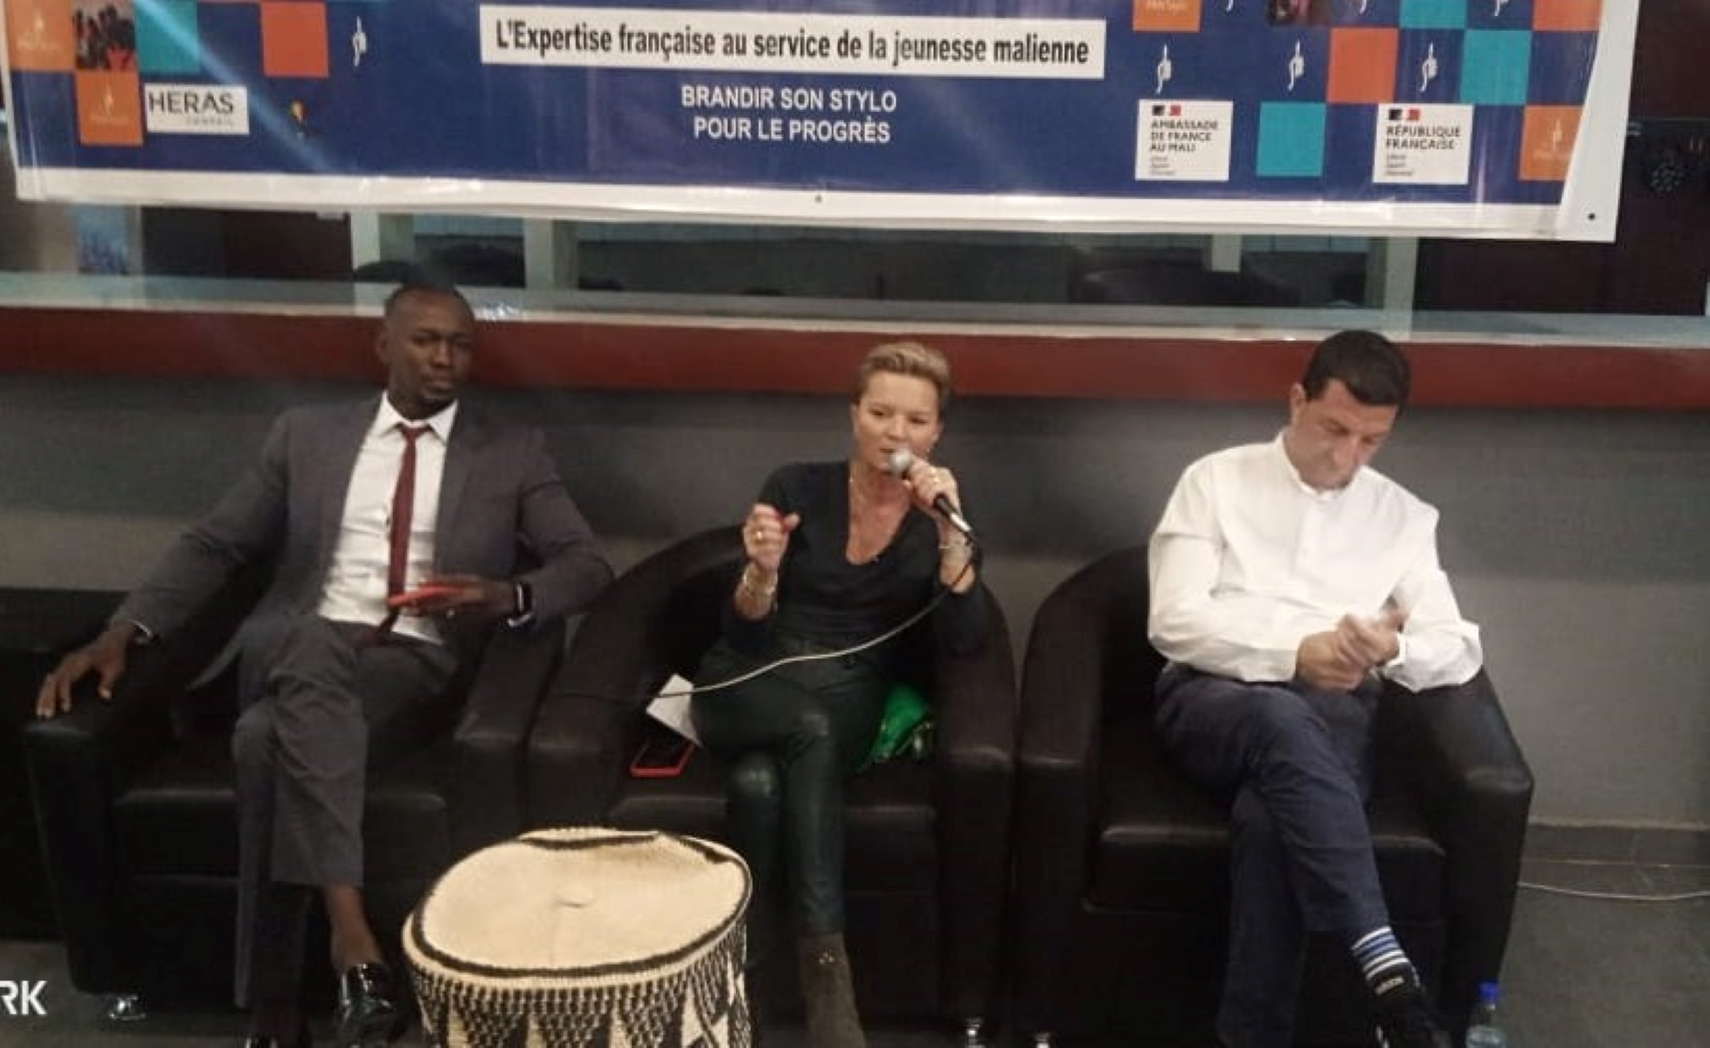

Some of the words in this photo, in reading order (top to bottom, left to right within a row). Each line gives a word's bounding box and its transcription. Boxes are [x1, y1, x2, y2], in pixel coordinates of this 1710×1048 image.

[496, 20, 612, 58] L'Expertise
[618, 23, 716, 61] française
[722, 35, 747, 56] au
[753, 28, 830, 59] service
[837, 29, 862, 59] de
[868, 31, 887, 60] la
[892, 31, 986, 67] jeunesse
[993, 33, 1089, 64] malienne
[148, 91, 235, 115] HERAS
[681, 85, 775, 109] BRANDIR
[780, 88, 824, 111] SON
[829, 89, 898, 113] STYLO
[693, 116, 752, 138] POUR
[757, 118, 783, 140] LE
[789, 115, 891, 143] PROGRÈS
[1151, 119, 1219, 130] AMBASSADE
[1386, 124, 1461, 138] RÉPUBLIQUE
[1151, 131, 1164, 141] DE
[1168, 131, 1213, 142] FRANCE
[1150, 143, 1165, 152] AU
[1168, 143, 1196, 153] MALI
